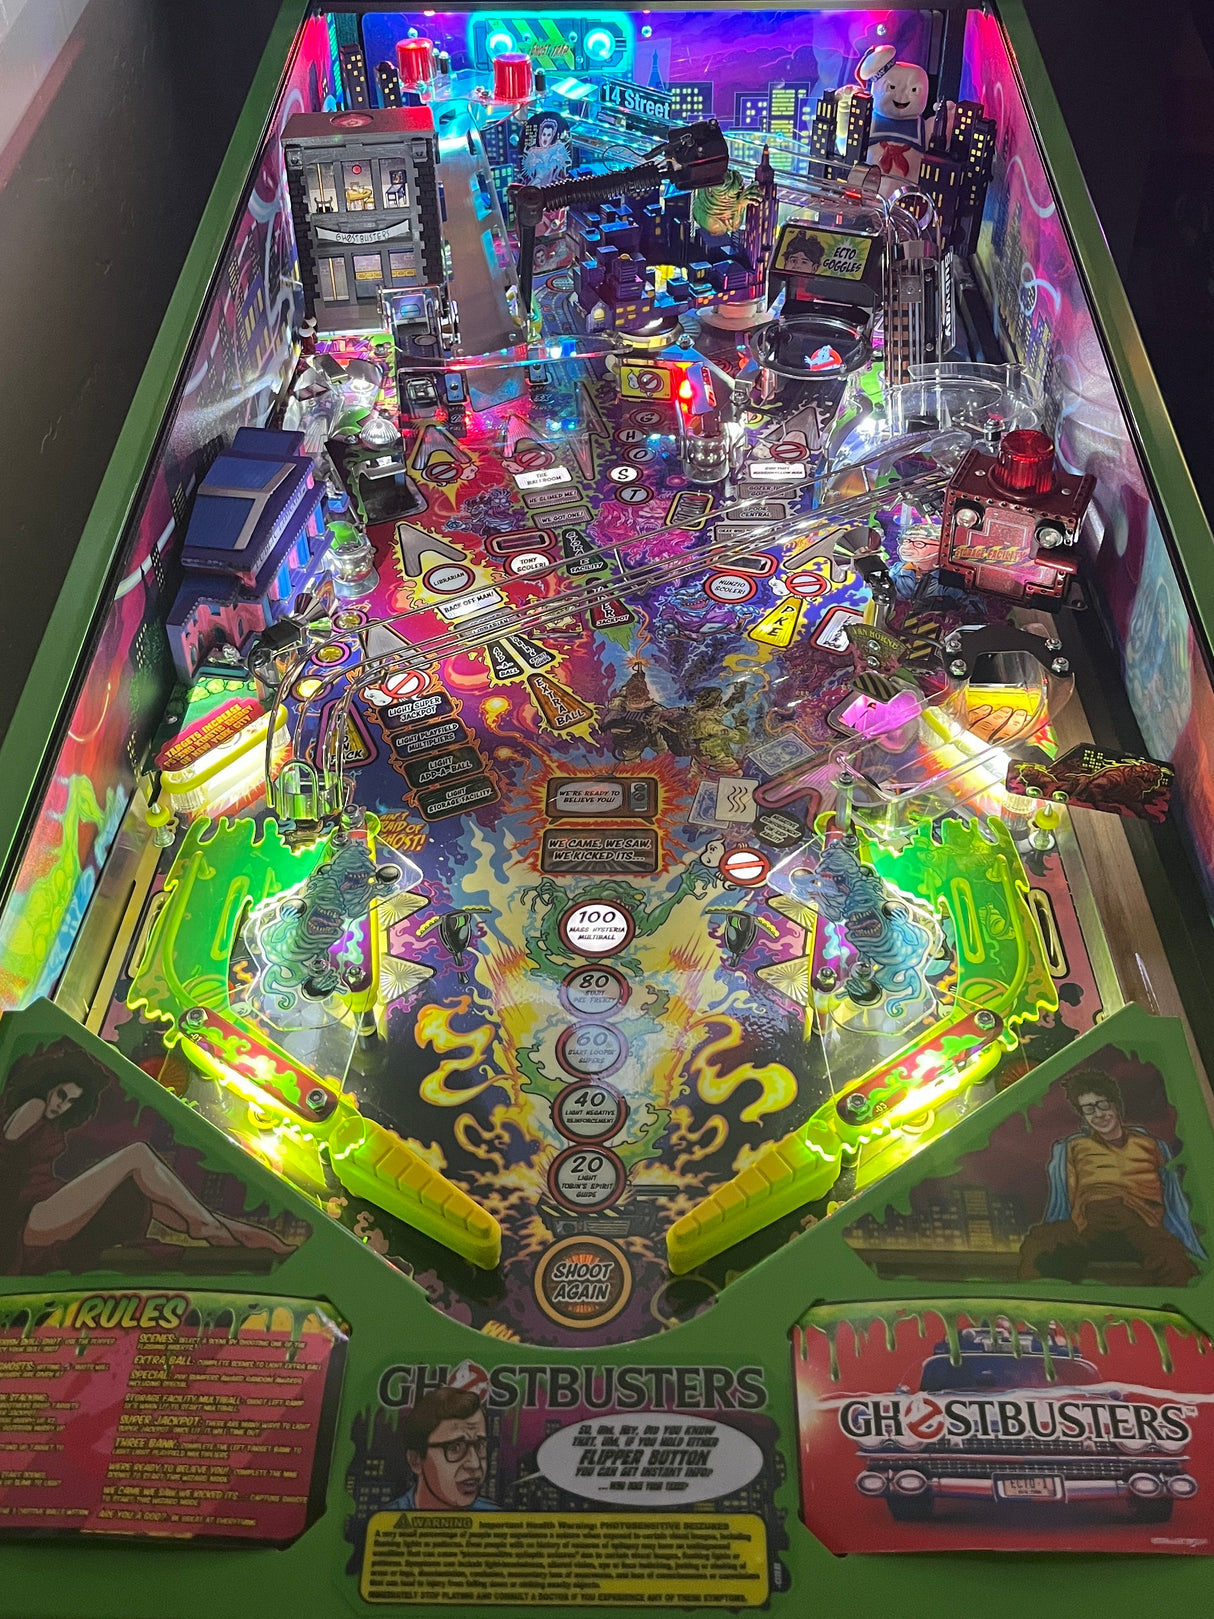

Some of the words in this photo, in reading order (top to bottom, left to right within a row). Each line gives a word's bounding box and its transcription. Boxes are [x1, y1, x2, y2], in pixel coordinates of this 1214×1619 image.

[603, 82, 621, 105] 14
[624, 88, 671, 120] Street
[833, 246, 857, 260] ECTO
[823, 259, 862, 273] GOGGLES
[626, 431, 636, 441] H
[634, 449, 648, 460] O
[618, 468, 630, 480] S
[540, 493, 563, 502] SLIMED
[628, 487, 643, 500] T
[567, 511, 584, 519] ONE!
[954, 547, 986, 559] STORAGE
[520, 556, 538, 565] TONY
[570, 561, 604, 574] FACILITY
[433, 572, 465, 586] LIBRARIAN
[718, 579, 746, 588] NUNZIO
[714, 585, 746, 595] SCOLERI
[443, 602, 462, 613] BACK
[463, 597, 476, 607] OFF
[476, 590, 494, 601] MAN!
[596, 614, 630, 627] JACKPOT
[852, 626, 868, 637] VAN
[868, 630, 899, 650] HORNE
[498, 667, 520, 678] BALL
[534, 677, 568, 714] EXTRA
[388, 703, 413, 718] LIGHT
[413, 696, 442, 709] SUPER
[400, 705, 437, 722] JACKPOT
[555, 709, 586, 726] BALL
[164, 730, 202, 758] TARGETS
[201, 703, 243, 734] INCREASE
[194, 724, 226, 747] KINETIC
[396, 733, 419, 747] LIGHT
[418, 722, 459, 739] PLAYFIELD
[180, 756, 193, 766] OF
[191, 742, 212, 757] NEW
[211, 727, 235, 743] YORK
[232, 714, 252, 729] CITY
[407, 732, 456, 753] MULTIPLIERS
[428, 755, 453, 770] LIGHT
[445, 786, 467, 799] LIGHT
[427, 797, 460, 813] STORAGE
[459, 787, 494, 803] FACILITY
[405, 823, 426, 833] OF
[548, 839, 568, 849] WE
[568, 839, 603, 849] CAME,
[604, 839, 624, 849] WE
[623, 839, 652, 849] SAW,
[553, 850, 573, 861] WE
[572, 850, 615, 861] KICKED
[578, 911, 616, 923] 100
[579, 974, 610, 988] 80
[576, 1032, 608, 1046] 60
[574, 1091, 607, 1107] 40
[571, 1156, 604, 1173] 20
[551, 1261, 615, 1281] SHOOT
[552, 1281, 611, 1302] AGAIN
[73, 1295, 189, 1329] RULES
[134, 1355, 166, 1364] EXTRA
[161, 1394, 198, 1402] FACILITY
[120, 1414, 152, 1424] SUPER
[839, 1399, 1193, 1443] GHOSTBUSTERS
[664, 1424, 683, 1436] YOU
[684, 1424, 716, 1436] KNOW
[115, 1437, 146, 1448] THREE
[624, 1436, 635, 1447] IF
[638, 1436, 658, 1447] YOU
[660, 1436, 685, 1447] HOLD
[686, 1436, 720, 1448] EITHER
[579, 1449, 645, 1466] FLIPPER
[647, 1449, 712, 1466] BUTTON
[132, 1463, 161, 1471] READY
[575, 1466, 596, 1478] YOU
[597, 1466, 619, 1477] CAN
[620, 1466, 639, 1477] GET
[640, 1466, 683, 1478] INSTANT
[412, 1517, 473, 1529] WARNING
[479, 1521, 524, 1530] Important
[600, 1521, 681, 1530] PHOTOSENSITIVE
